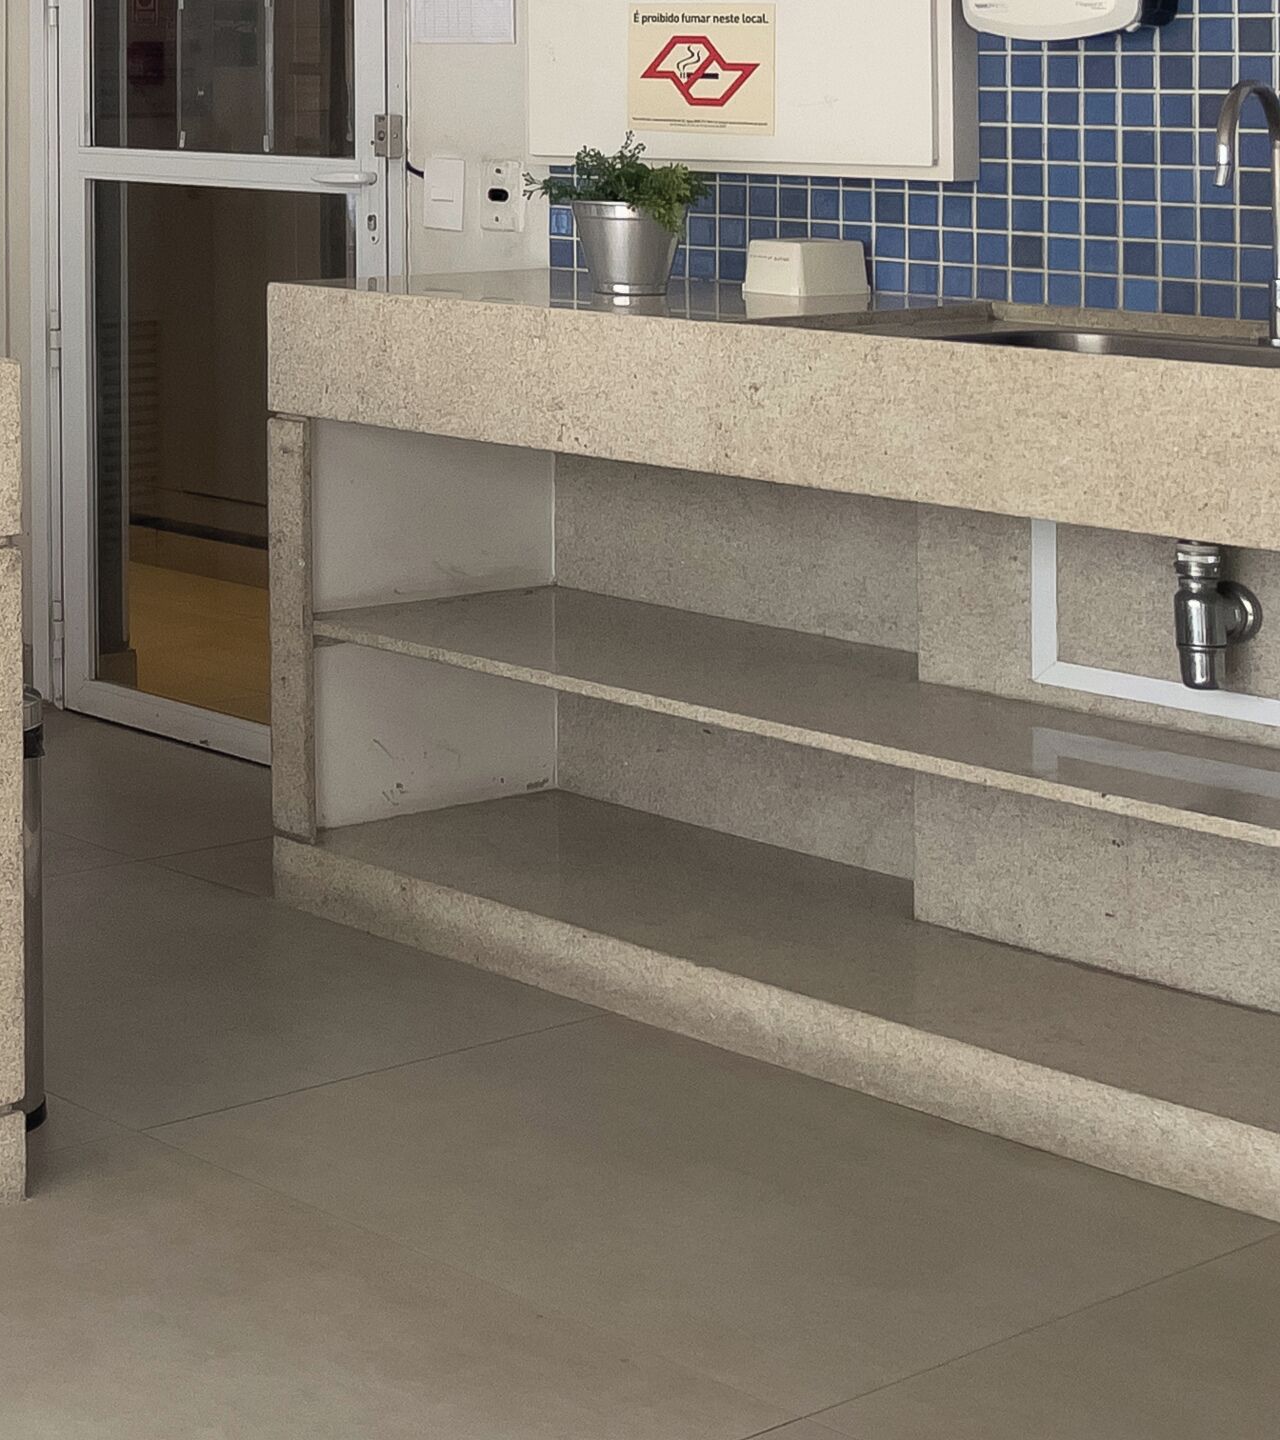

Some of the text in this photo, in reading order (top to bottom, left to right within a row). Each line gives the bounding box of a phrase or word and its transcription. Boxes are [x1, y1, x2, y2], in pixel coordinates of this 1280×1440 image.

[633, 10, 769, 25] É proibido fumar neste local.
